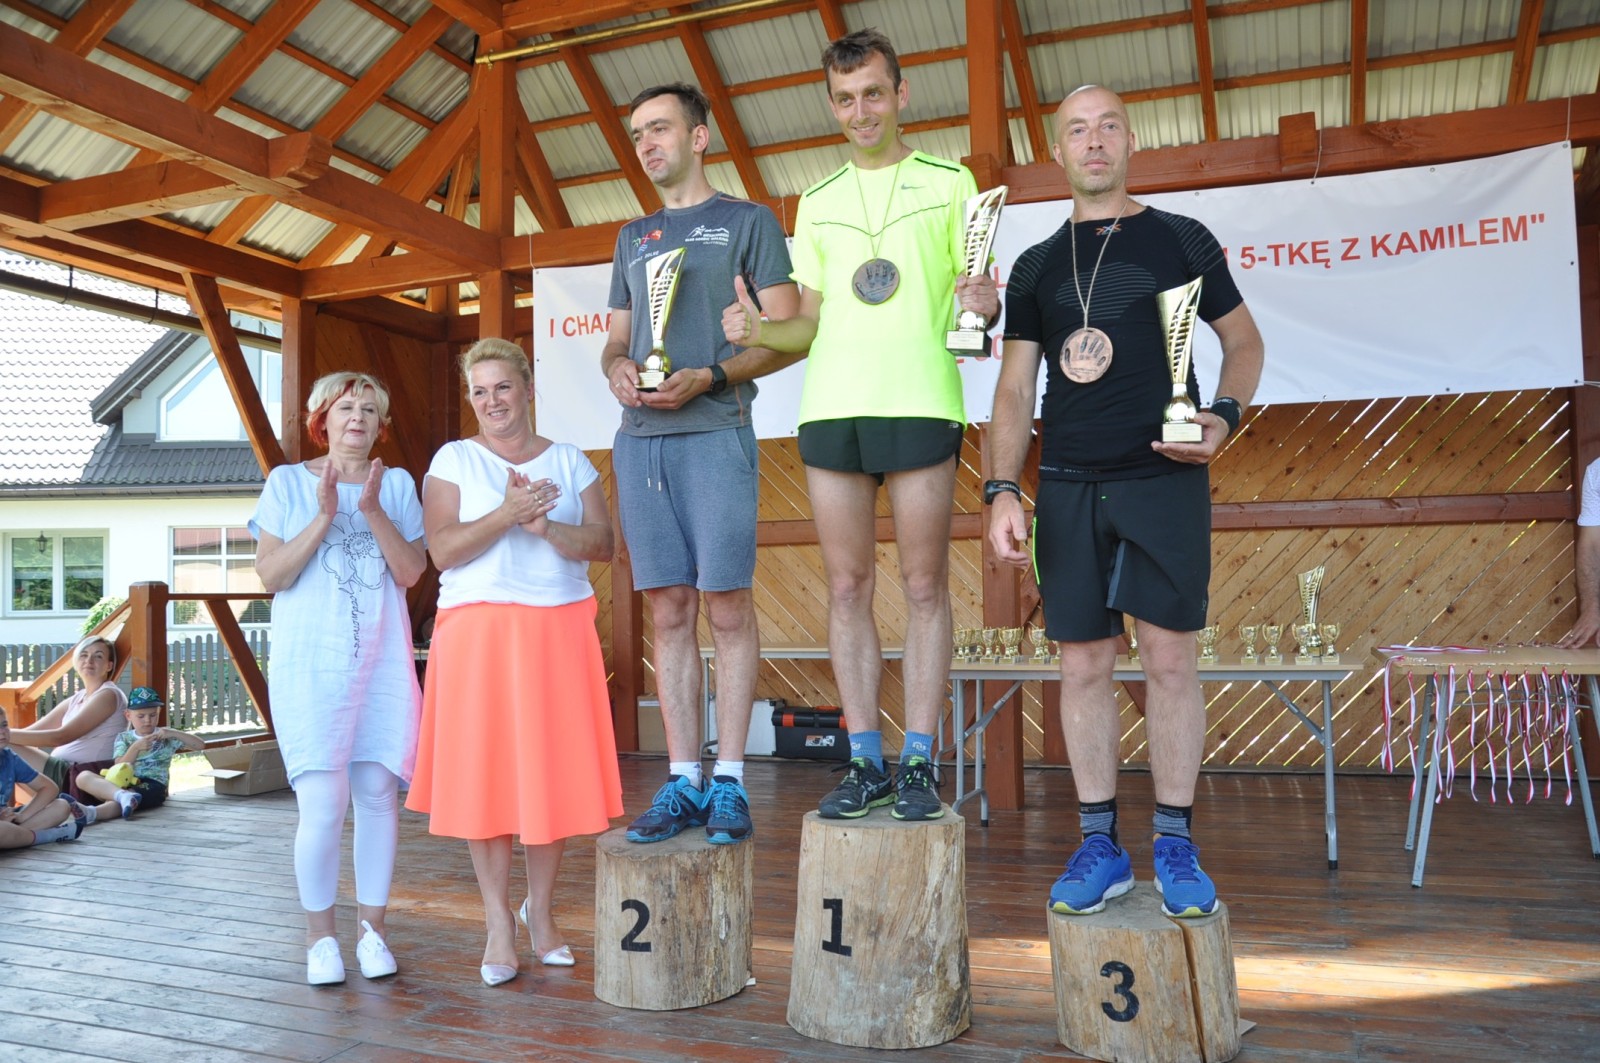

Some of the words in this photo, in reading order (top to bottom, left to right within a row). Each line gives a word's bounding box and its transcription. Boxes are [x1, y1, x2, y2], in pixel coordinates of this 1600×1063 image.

[550, 318, 555, 338] I
[1240, 240, 1331, 269] 5-TKĘ
[1341, 237, 1361, 261] Z
[1371, 213, 1545, 258] KAMILEM"
[621, 899, 652, 952] 2
[822, 898, 852, 957] 1
[1100, 960, 1140, 1023] 3
